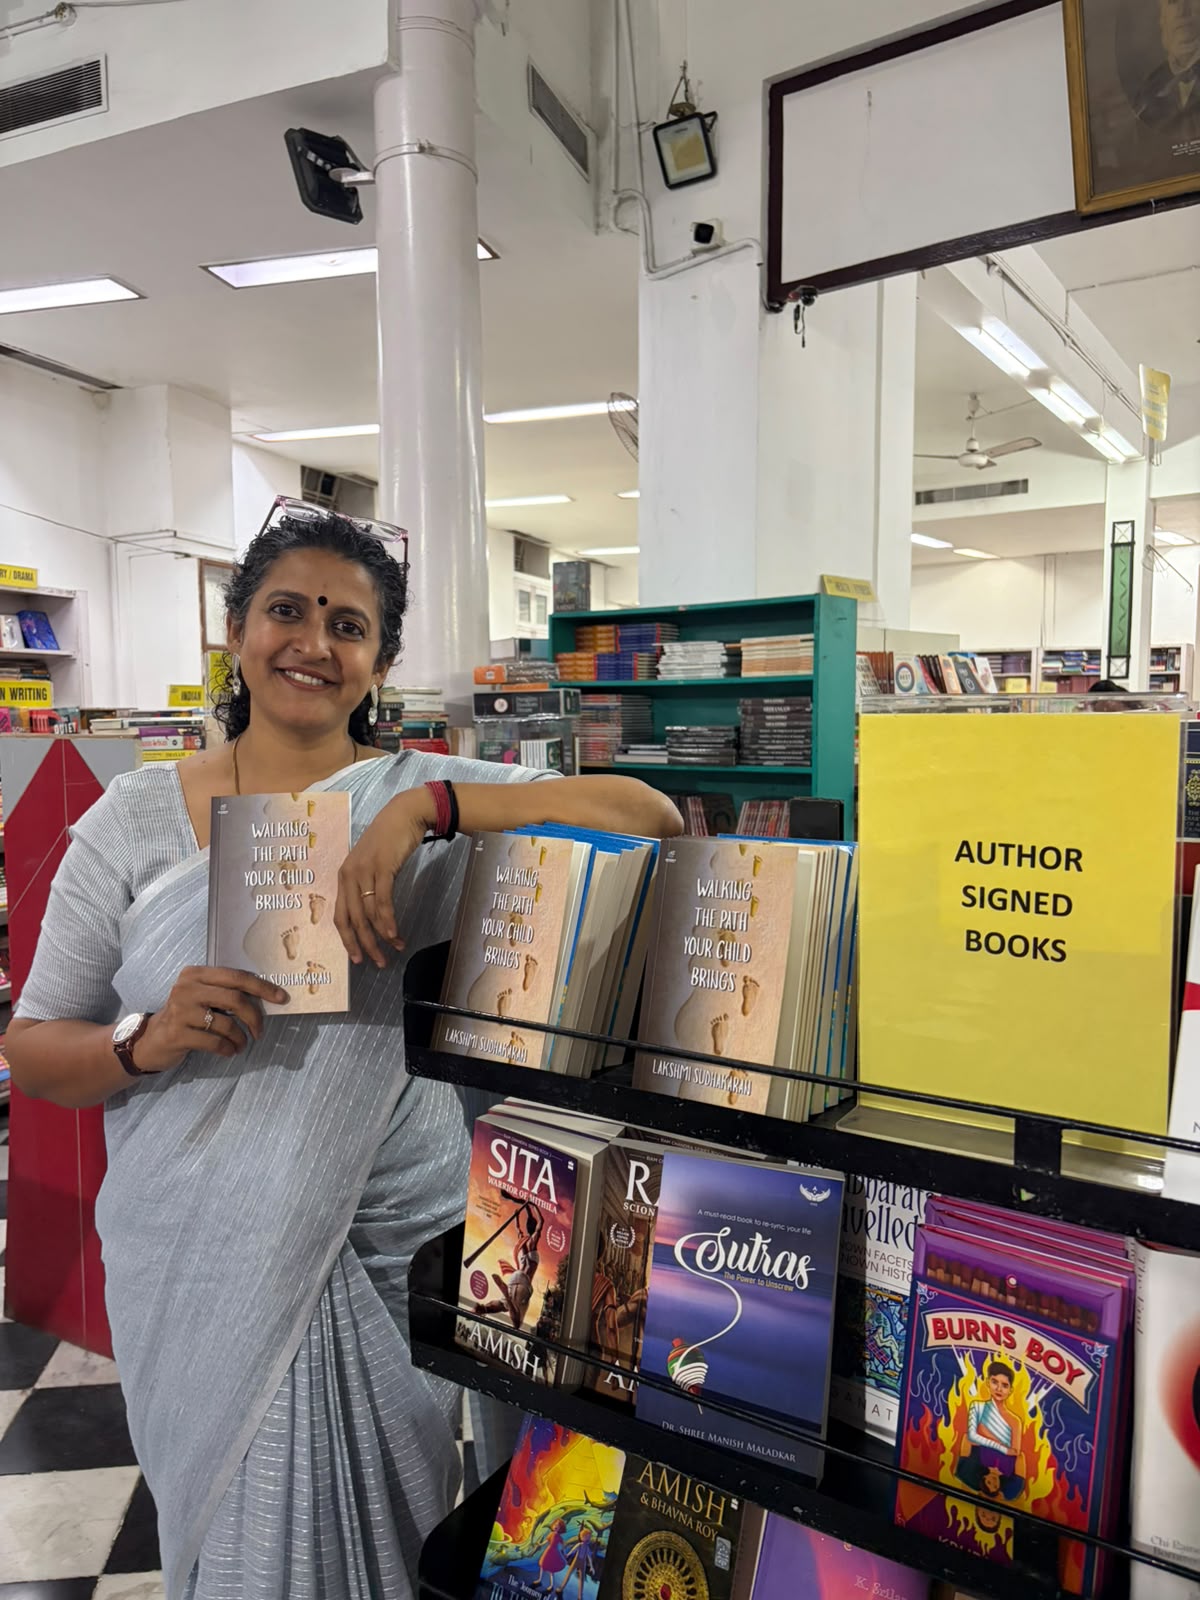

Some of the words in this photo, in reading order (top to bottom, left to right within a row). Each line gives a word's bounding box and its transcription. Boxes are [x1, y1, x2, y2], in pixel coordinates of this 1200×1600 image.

[13, 570, 34, 582] DRAMA
[10, 687, 48, 701] WRITING
[252, 821, 310, 838] WALKING
[252, 846, 276, 862] THE
[280, 845, 308, 861] PATH
[954, 839, 1083, 872] AUTHOR
[244, 870, 275, 887] YOUR
[279, 869, 315, 885] CHILD
[496, 865, 539, 888] WALKING
[256, 893, 302, 910] BRINGS
[697, 878, 753, 901] WALKING
[961, 885, 1073, 917] SIGNED
[493, 892, 510, 911] THE
[511, 896, 533, 915] PATH
[481, 918, 506, 938] YOUR
[507, 922, 534, 944] CHILD
[695, 907, 716, 927] THE
[719, 910, 748, 931] PATH
[484, 945, 520, 969] BRINGS
[684, 936, 713, 958] YOUR
[716, 940, 752, 962] CHILD
[965, 929, 1067, 962] BOOKS
[270, 972, 332, 986] SUDHAKARAN
[691, 967, 735, 992] BRINGS
[445, 1028, 478, 1049] LAKSHMI
[479, 1036, 528, 1063] SUDHAKARAN
[652, 1059, 692, 1082] LAKSHMI
[693, 1068, 752, 1096] SUDHAKARAN
[488, 1138, 558, 1205] SITA
[625, 1159, 660, 1206] R
[488, 1176, 518, 1196] WARRIOR
[518, 1189, 529, 1201] OF
[529, 1194, 557, 1214] MITHILA
[623, 1202, 656, 1217] SCION
[704, 1210, 736, 1222] must-read
[737, 1213, 753, 1224] book
[754, 1218, 761, 1226] to
[762, 1222, 785, 1232] re-sync
[786, 1226, 801, 1235] your
[801, 1228, 812, 1236] life
[674, 1226, 816, 1290] Sutras
[874, 1250, 913, 1271] FACETS
[724, 1271, 735, 1281] The
[736, 1273, 756, 1285] Power
[757, 1277, 765, 1287] to
[765, 1279, 794, 1292] Unscrew
[468, 1322, 540, 1383] AMISH
[931, 1317, 1017, 1350] BURNS
[1026, 1337, 1085, 1386] BOY
[636, 1461, 726, 1527] AMISH
[640, 1492, 649, 1505] &
[651, 1497, 693, 1529] BHAVNA
[695, 1522, 718, 1541] ROY
[507, 1574, 519, 1587] The
[520, 1581, 543, 1600] Journey
[854, 1574, 869, 1591] K.
